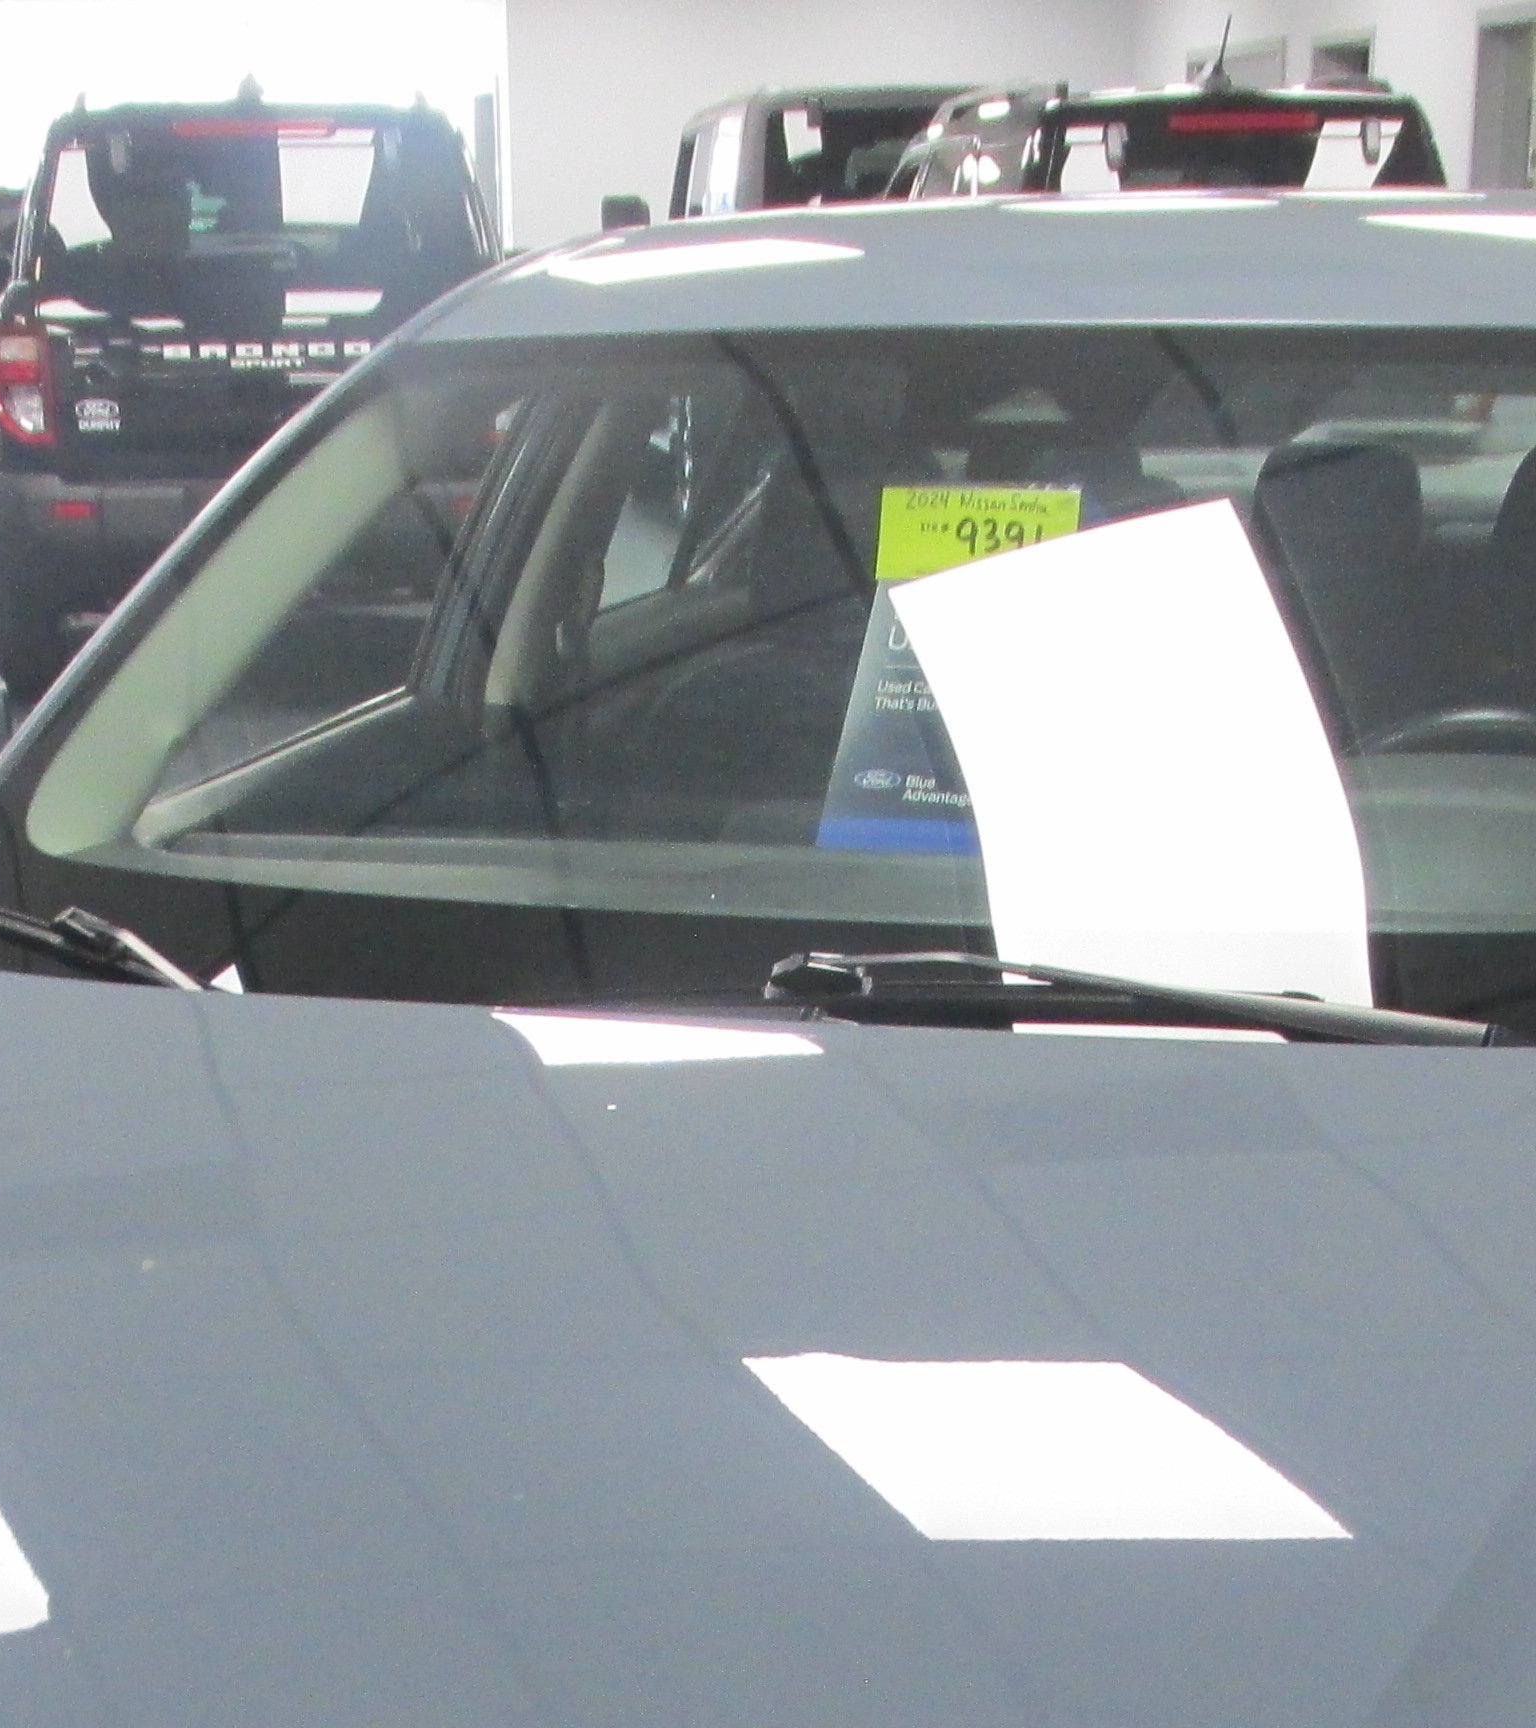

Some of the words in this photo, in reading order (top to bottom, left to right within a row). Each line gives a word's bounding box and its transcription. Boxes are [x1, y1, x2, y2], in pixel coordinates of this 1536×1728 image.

[906, 490, 950, 511] 2024
[877, 680, 912, 694] Used
[874, 695, 914, 711] That's
[906, 774, 936, 789] Blue
